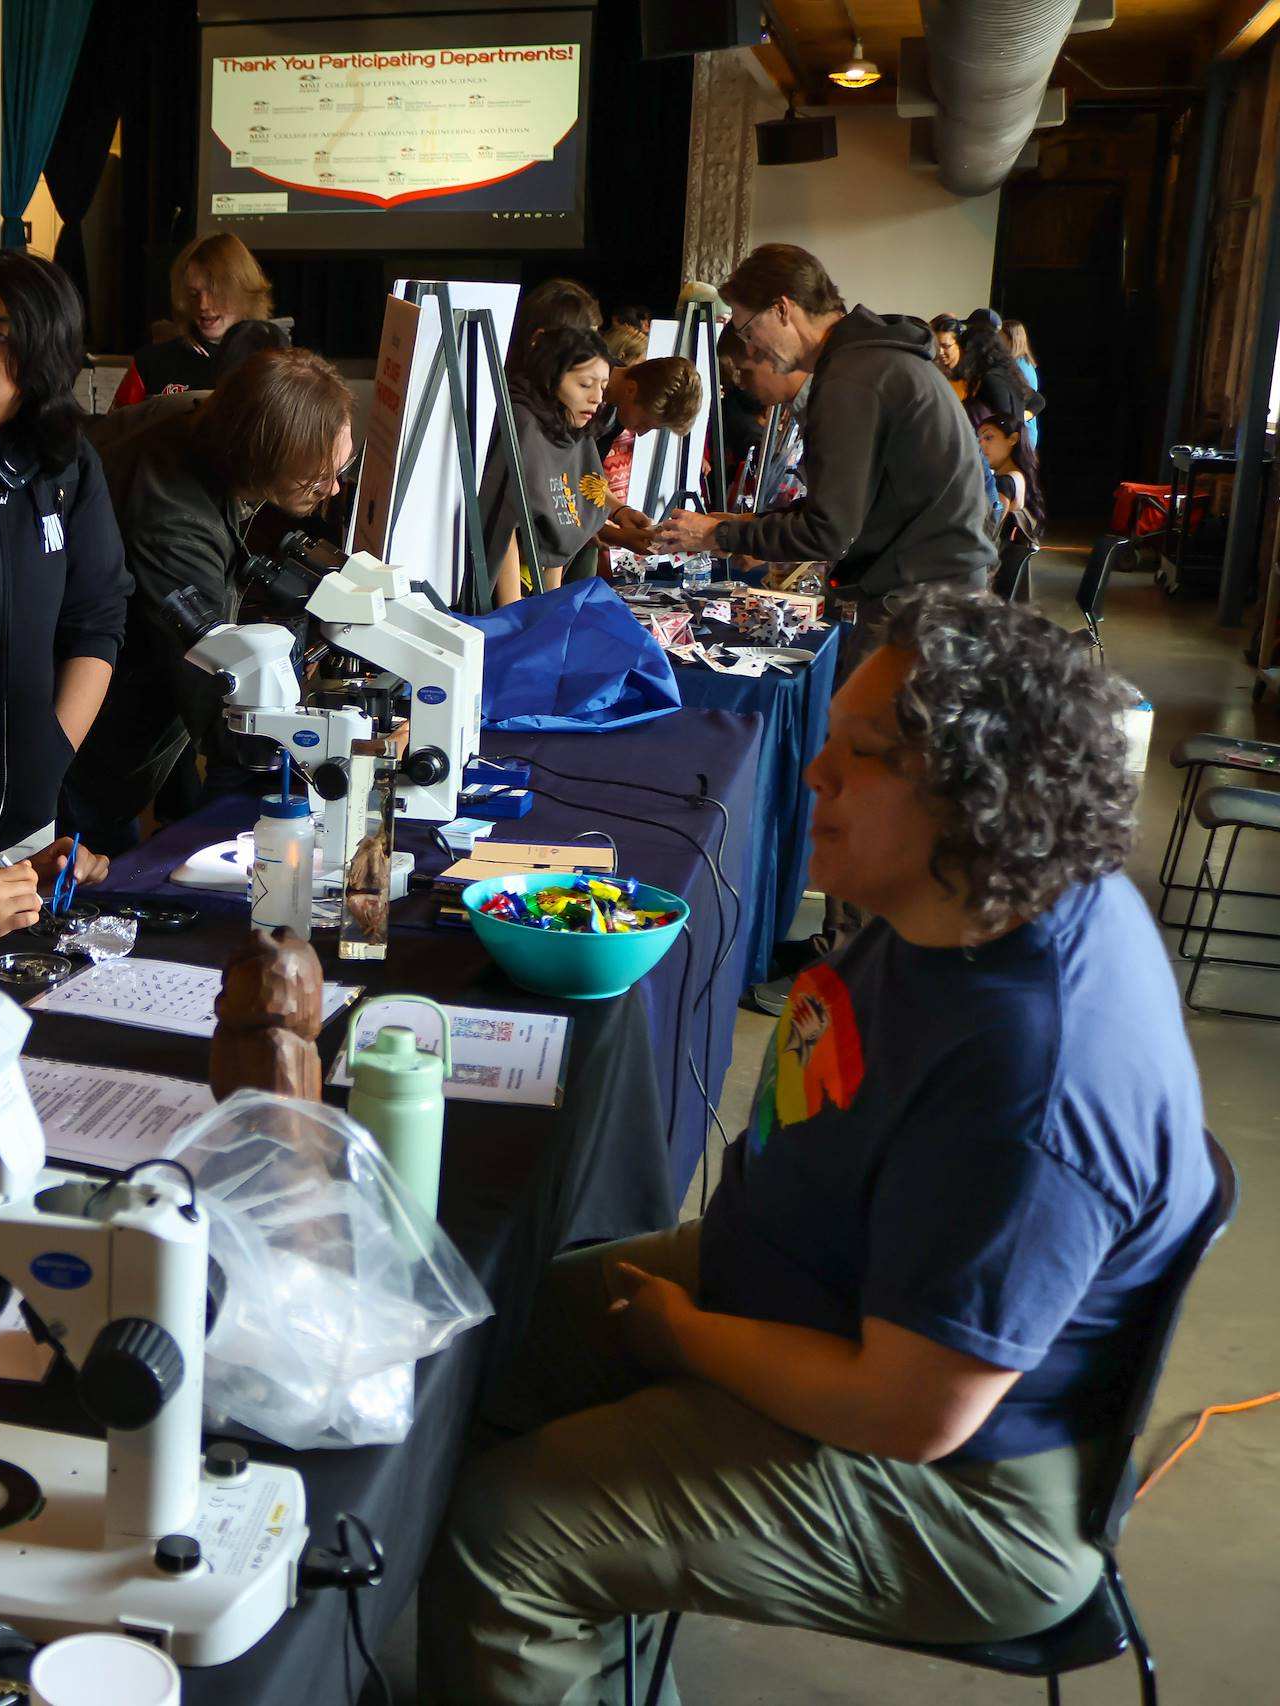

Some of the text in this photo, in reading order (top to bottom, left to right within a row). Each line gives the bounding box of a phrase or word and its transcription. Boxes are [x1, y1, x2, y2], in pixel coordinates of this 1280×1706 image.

[222, 46, 573, 72] Thank You Participating Departments!
